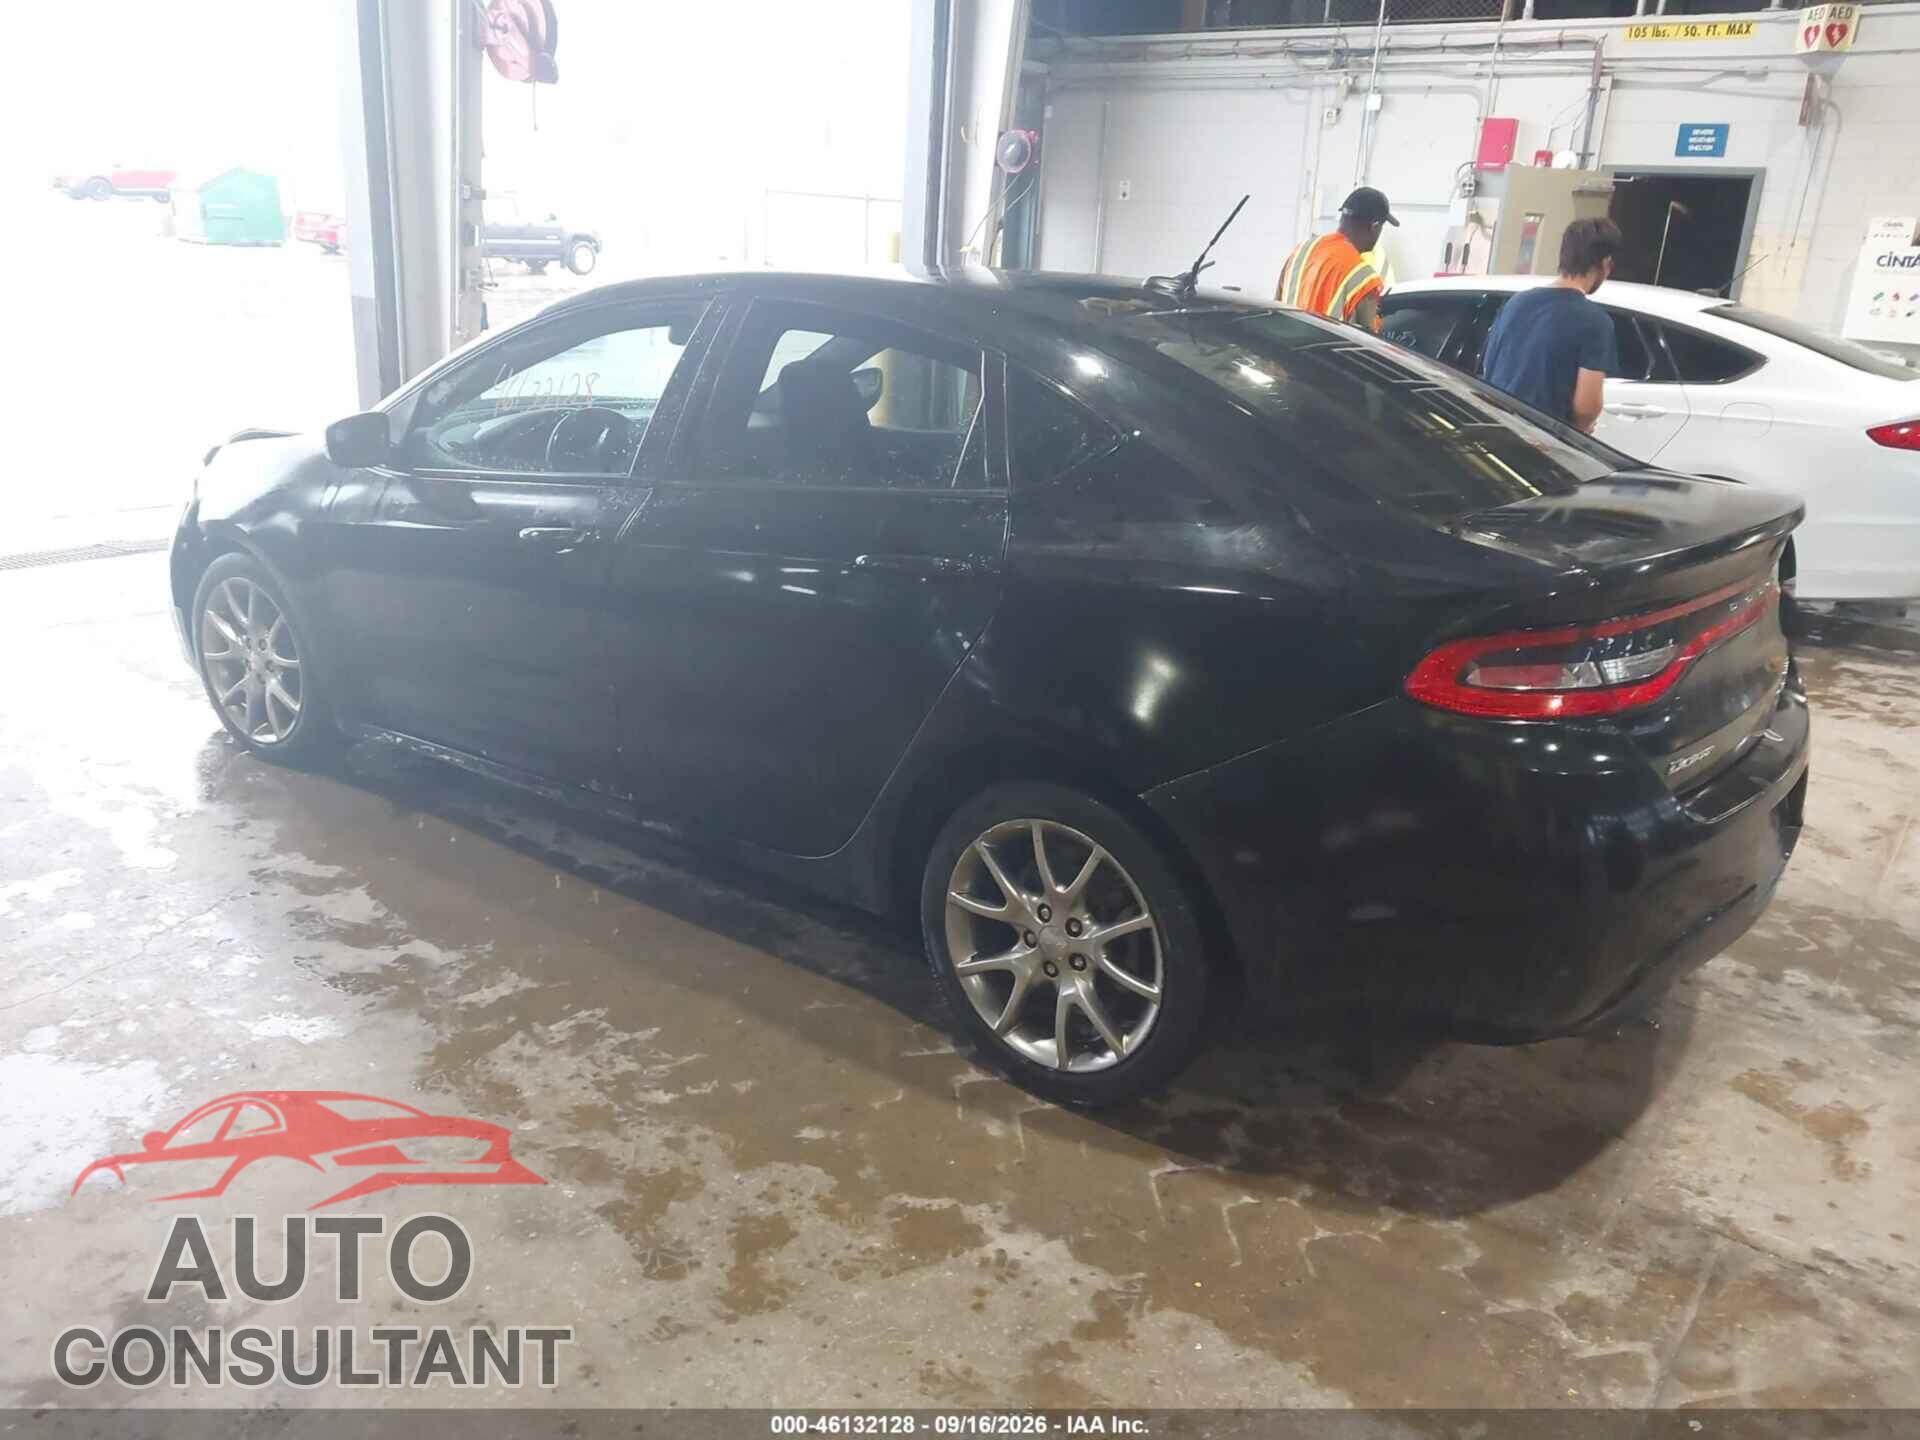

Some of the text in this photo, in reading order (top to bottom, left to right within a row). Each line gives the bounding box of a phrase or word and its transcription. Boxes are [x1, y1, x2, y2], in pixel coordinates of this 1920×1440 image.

[1829, 6, 1852, 18] AED
[1628, 26, 1647, 38] 105
[1651, 25, 1670, 38] lbs.
[1684, 24, 1700, 37] SQ.
[1706, 24, 1720, 36] FT.
[1726, 23, 1752, 35] MAX
